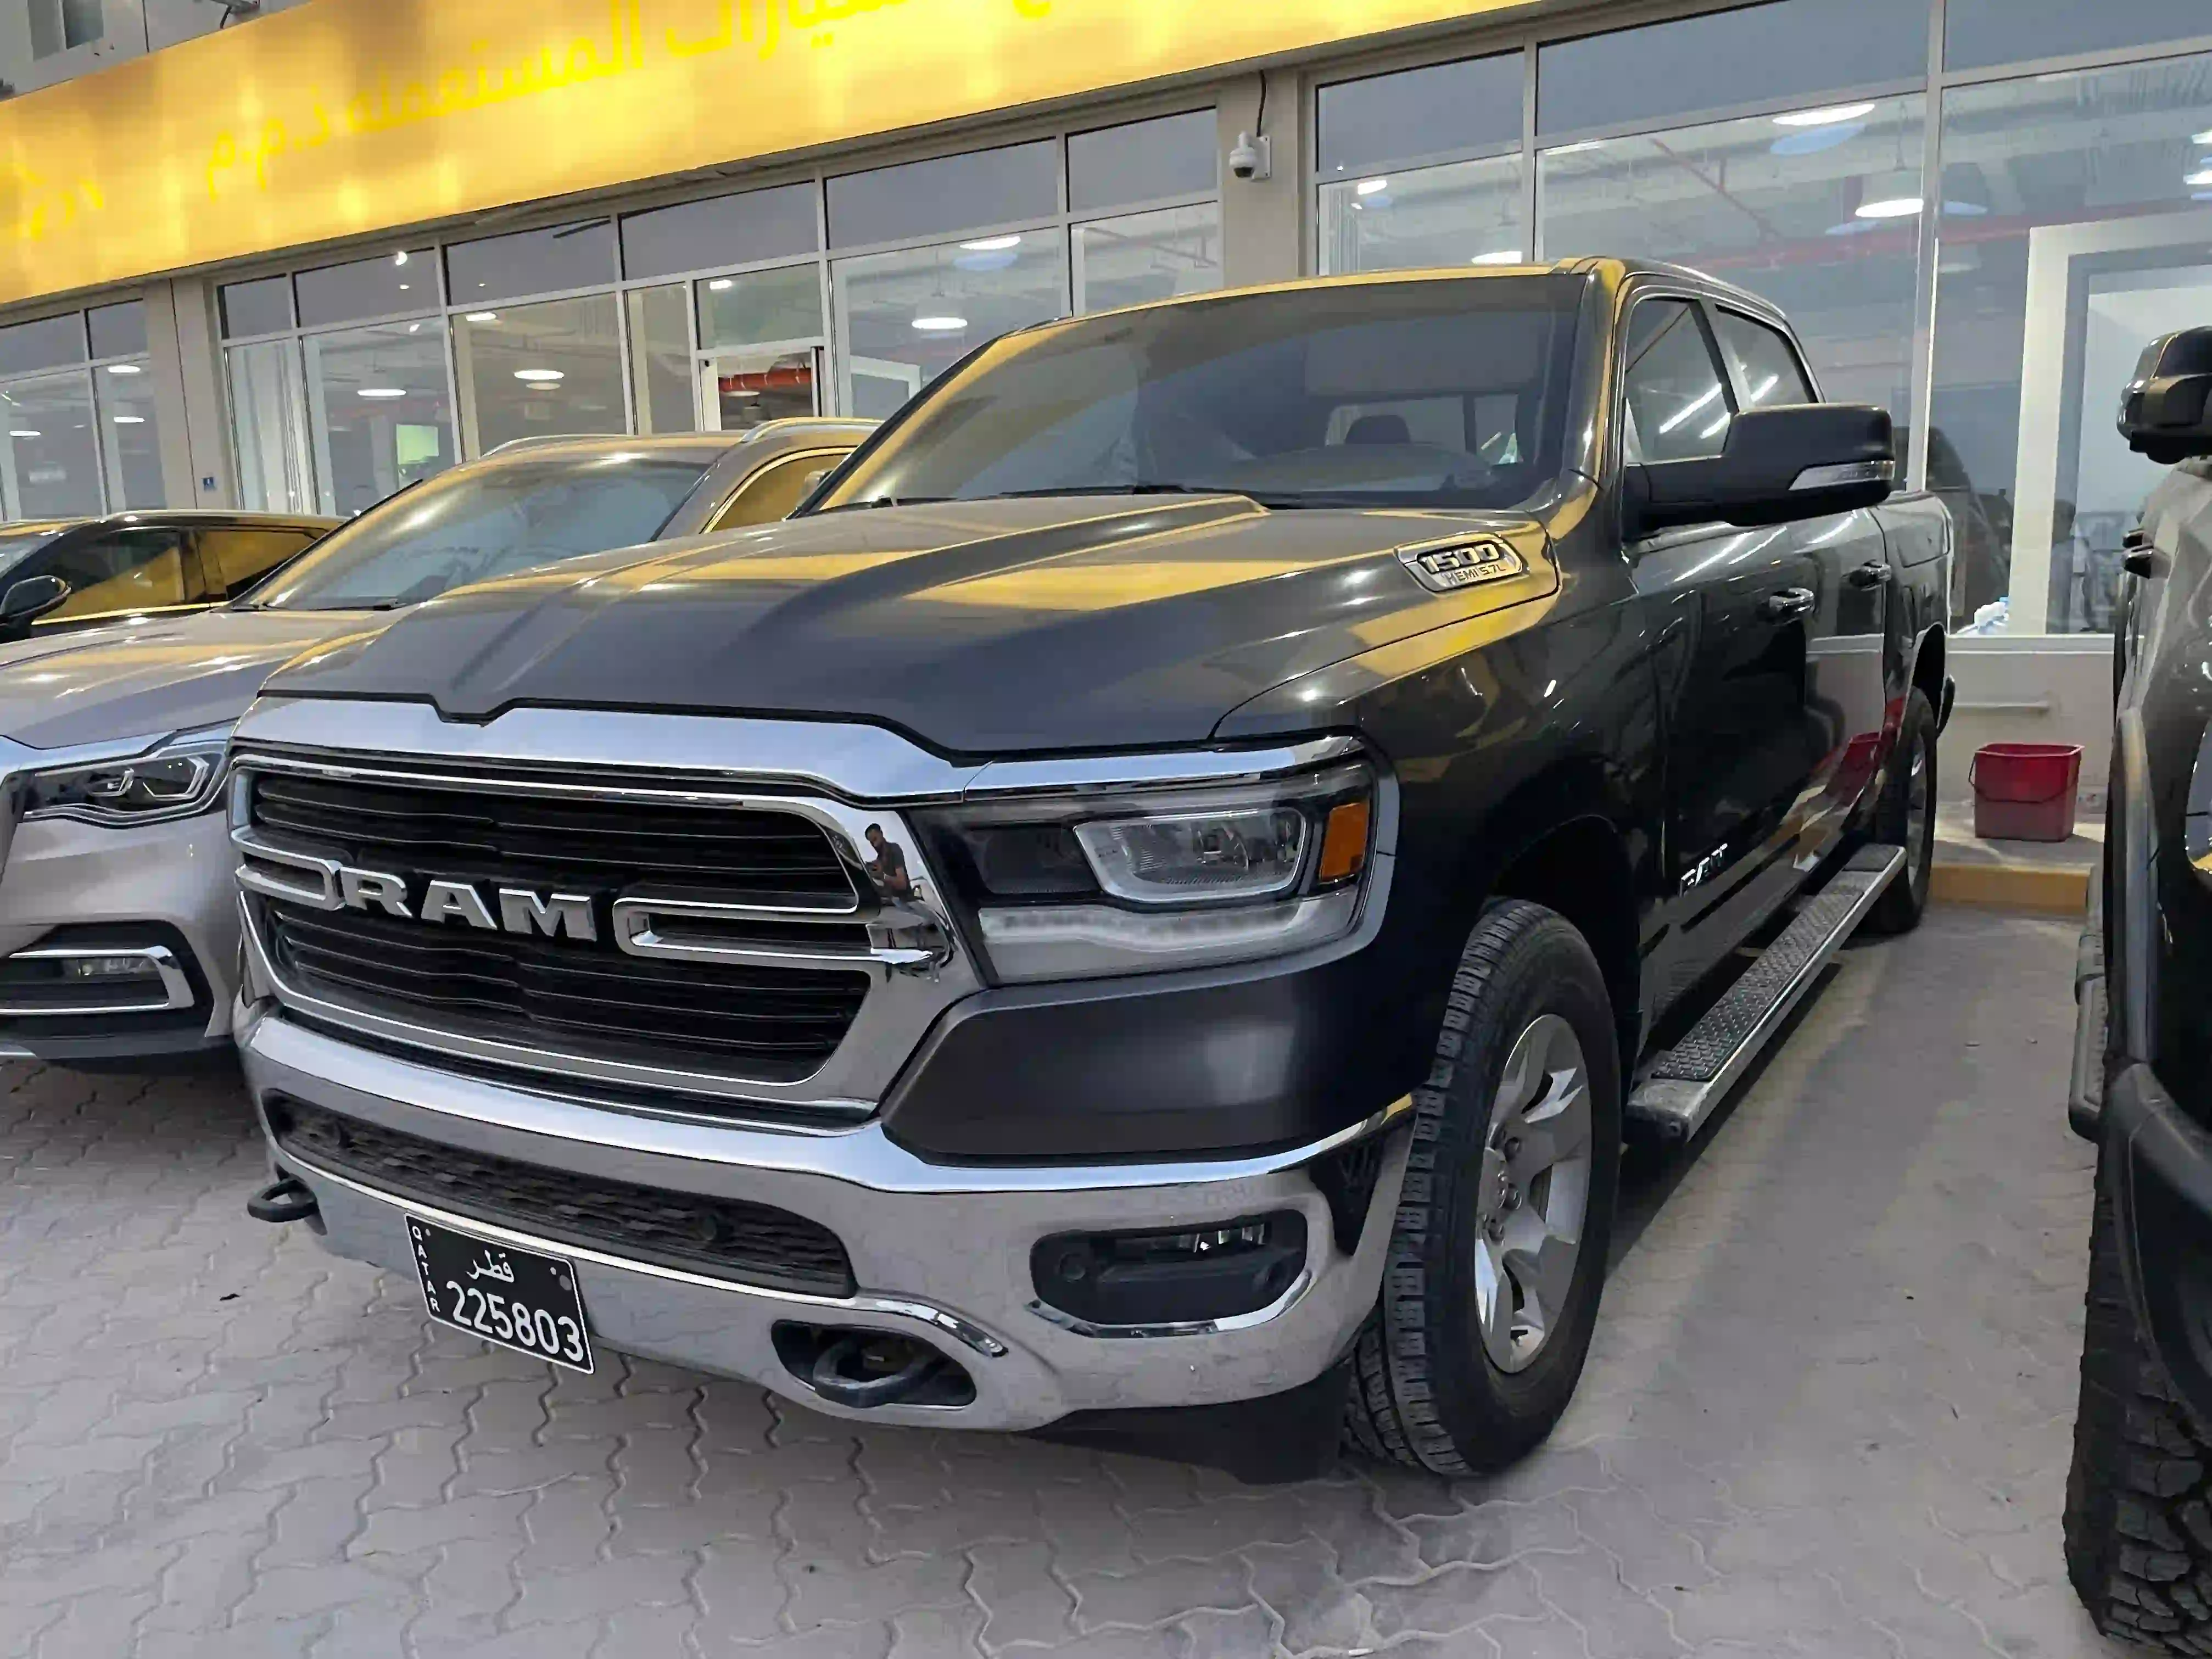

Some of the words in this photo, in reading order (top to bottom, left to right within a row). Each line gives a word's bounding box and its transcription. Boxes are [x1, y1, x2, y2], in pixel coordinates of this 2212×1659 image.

[1418, 543, 1500, 574] 1500
[1442, 569, 1479, 586] HEMI
[340, 866, 597, 941] RAM
[411, 1225, 441, 1312] QATAR
[466, 1249, 515, 1283] قطر
[446, 1281, 584, 1362] 225803
